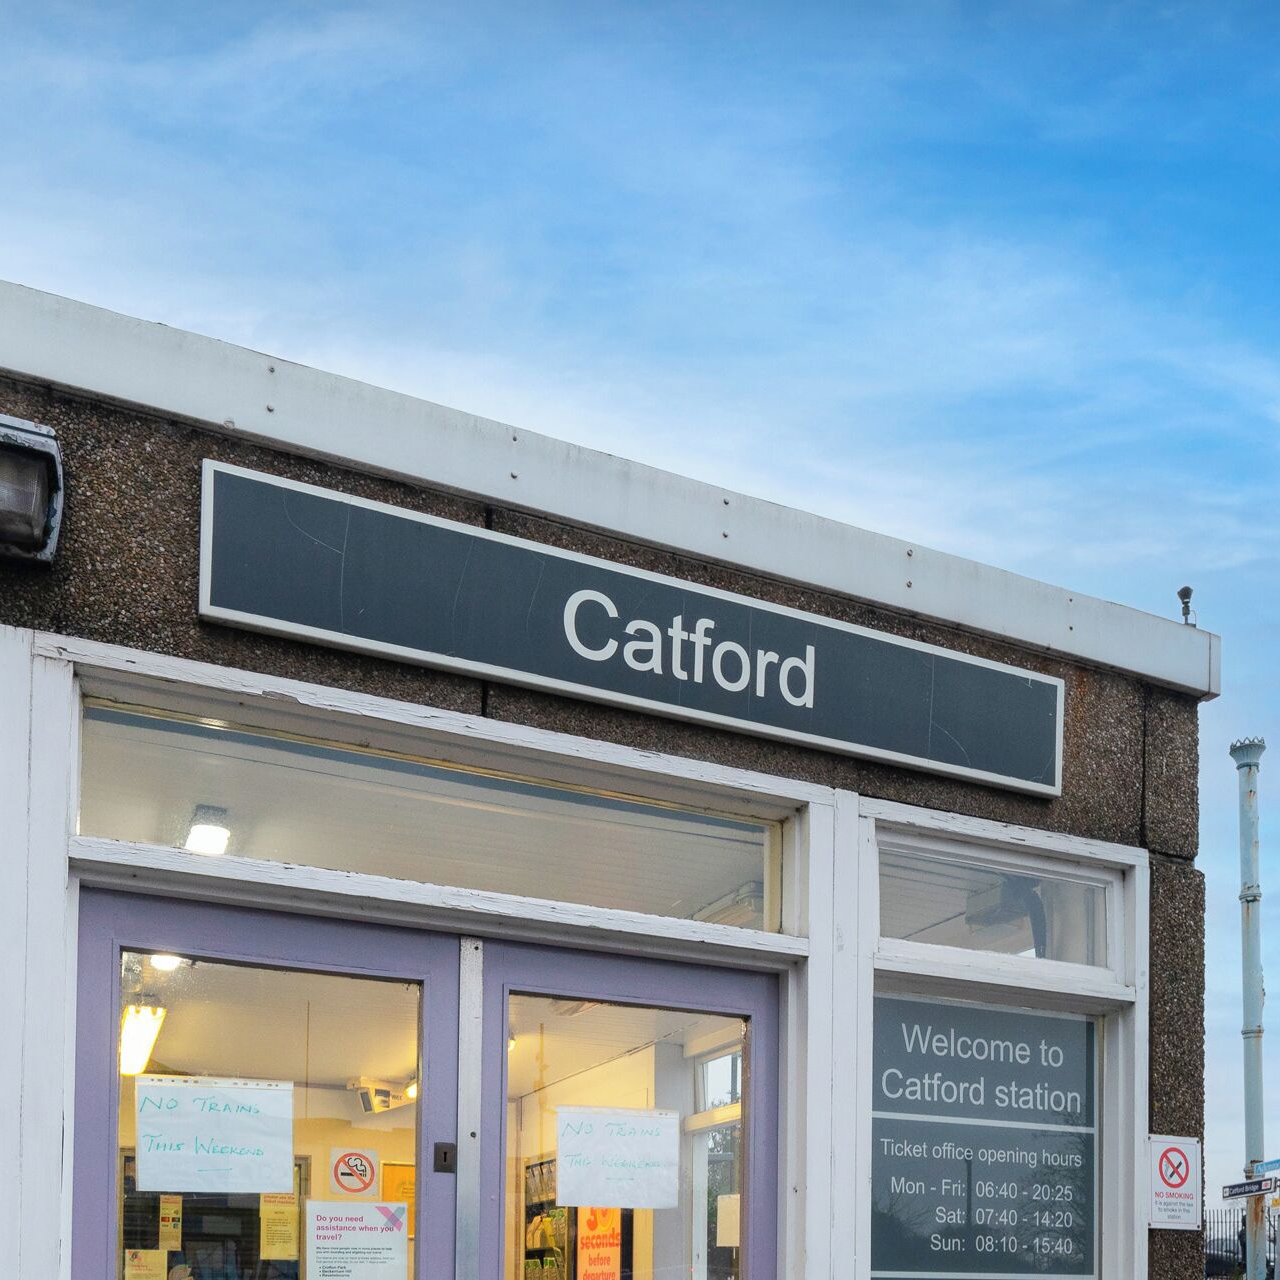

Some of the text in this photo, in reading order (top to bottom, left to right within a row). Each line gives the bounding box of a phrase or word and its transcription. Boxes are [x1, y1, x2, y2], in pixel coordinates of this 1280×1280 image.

[563, 589, 815, 709] Catford
[901, 1023, 1064, 1067] Welcome to
[881, 1068, 1081, 1113] Catford station
[139, 1096, 261, 1114] NO TRAINS
[142, 1134, 185, 1153] THIS
[880, 1138, 1082, 1169] Ticket office opening hours
[891, 1176, 925, 1195] Mon
[942, 1179, 966, 1197] Fri:
[975, 1181, 1018, 1199] 06:40
[1032, 1184, 1073, 1201] 20:25
[1155, 1191, 1194, 1200] NO SMOKING
[1229, 1184, 1259, 1196] Catford Bridge
[316, 1214, 327, 1222] Do
[329, 1216, 343, 1224] you
[935, 1206, 966, 1224] Sat:
[975, 1208, 1018, 1226] 07:40
[1033, 1211, 1073, 1228] 14:20
[316, 1224, 357, 1232] assistance
[381, 1226, 394, 1234] you
[580, 1227, 621, 1250] seconds
[930, 1234, 966, 1251] Sun:
[975, 1235, 1018, 1254] 08:10
[1033, 1238, 1073, 1255] 15:40
[588, 1254, 611, 1268] before
